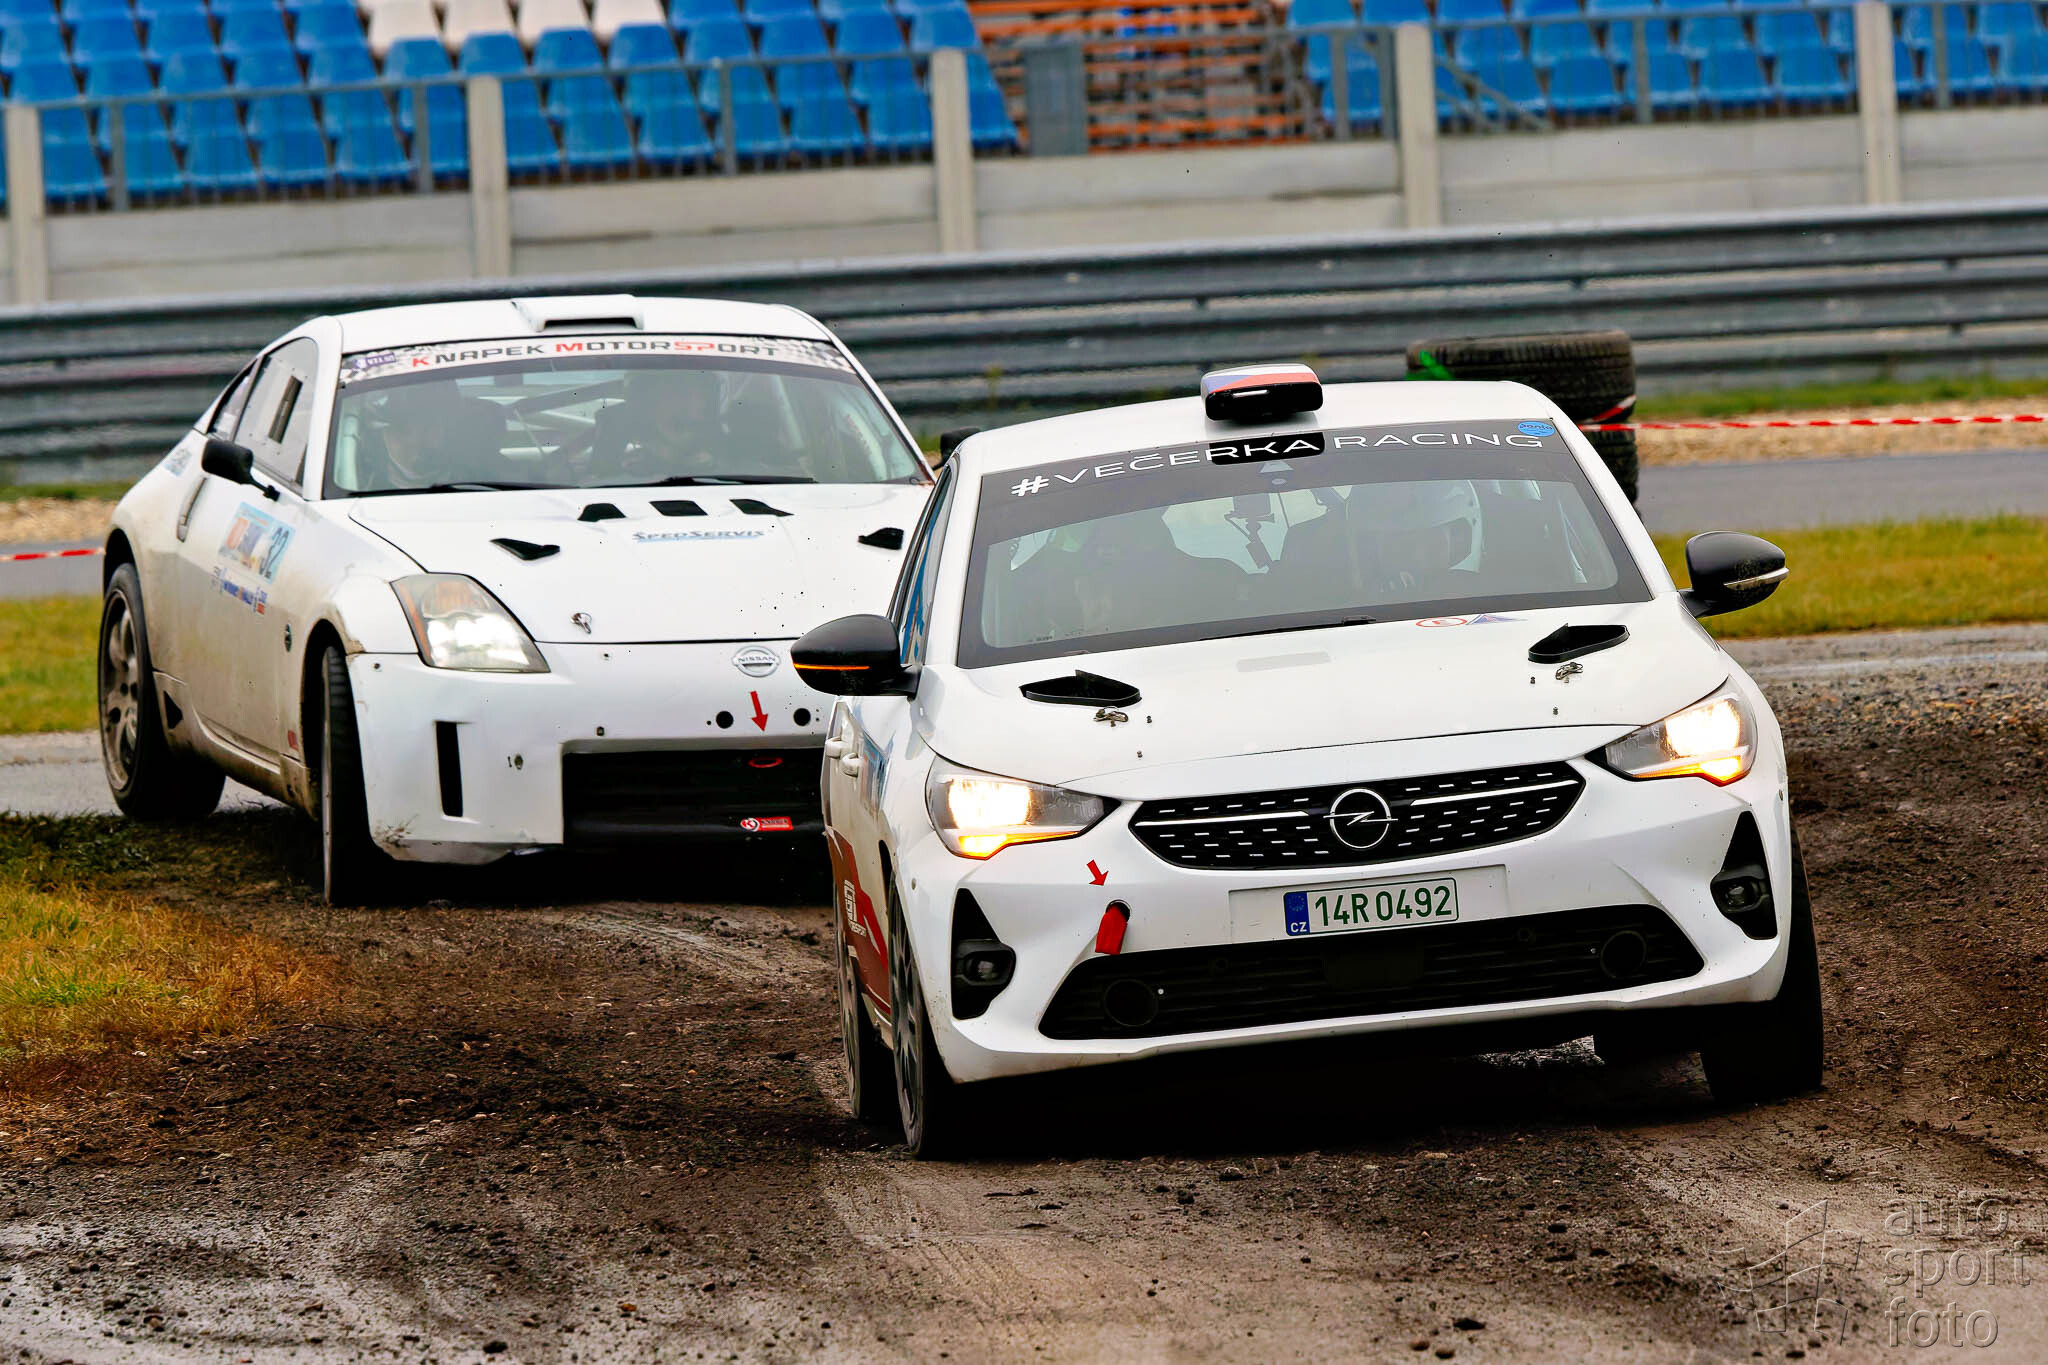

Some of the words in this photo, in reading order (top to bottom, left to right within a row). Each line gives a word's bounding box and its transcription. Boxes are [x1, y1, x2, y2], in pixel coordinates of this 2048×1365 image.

[412, 344, 543, 367] KNAPEK
[555, 341, 778, 357] MOTORSPORT
[1011, 439, 1320, 497] #VEČERKA
[1333, 433, 1543, 448] RACING
[1290, 921, 1307, 933] CZ
